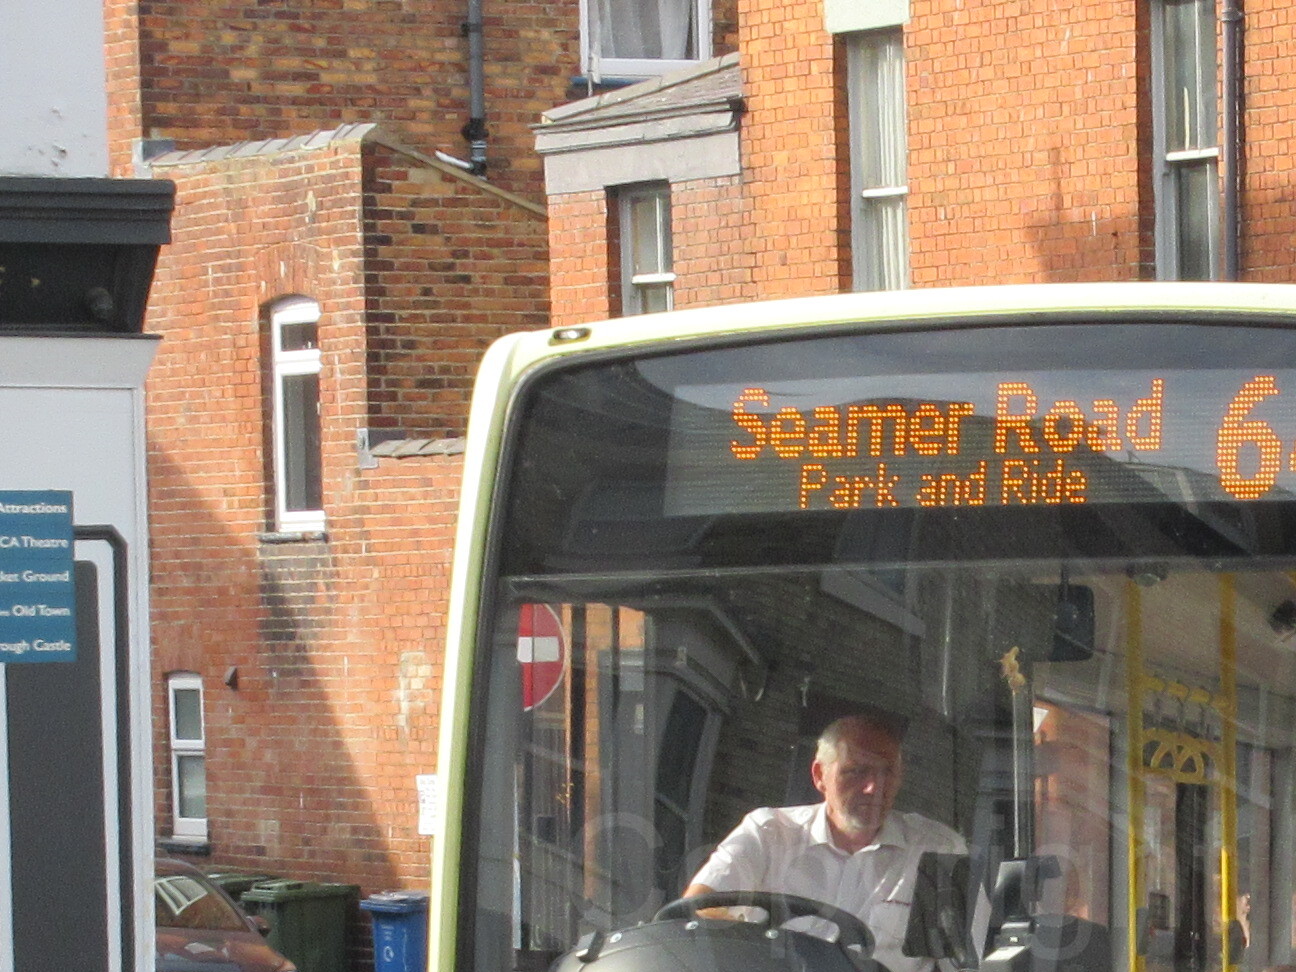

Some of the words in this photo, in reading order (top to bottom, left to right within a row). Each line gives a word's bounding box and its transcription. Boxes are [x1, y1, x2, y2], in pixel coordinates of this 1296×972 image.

[730, 387, 975, 459] Seamer
[995, 378, 1164, 453] Road
[800, 463, 899, 509] Park
[916, 461, 987, 507] and
[1001, 459, 1087, 505] Ride
[23, 570, 69, 582] Ground
[12, 604, 36, 617] Old
[36, 604, 71, 617] Town
[33, 639, 71, 652] Castle
